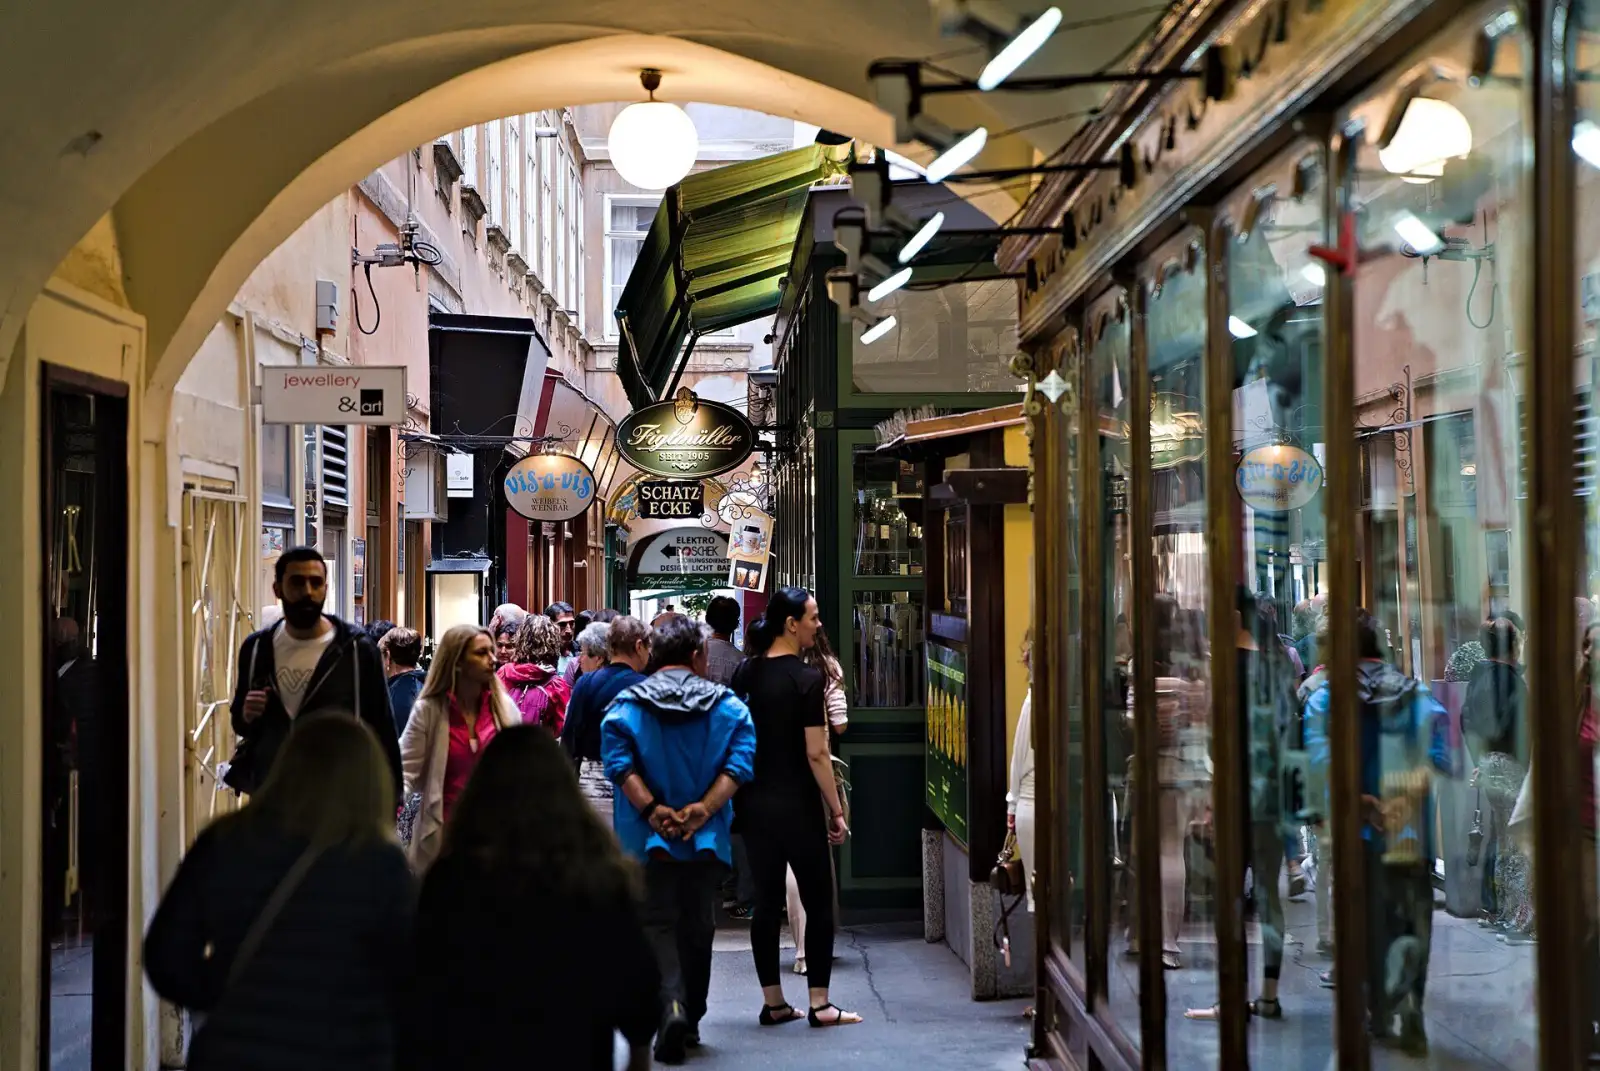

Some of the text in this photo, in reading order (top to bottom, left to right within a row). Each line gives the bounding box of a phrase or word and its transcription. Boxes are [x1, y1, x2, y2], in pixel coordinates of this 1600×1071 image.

[284, 373, 360, 389] jewellery
[338, 396, 382, 413] & art
[627, 424, 741, 452] Figlmüller
[660, 452, 710, 461] SEIT 1905
[505, 469, 592, 499] vis-a-vis
[641, 486, 700, 500] SCHATZ
[649, 501, 692, 515] ECKE
[676, 536, 715, 544] ELEKTRO
